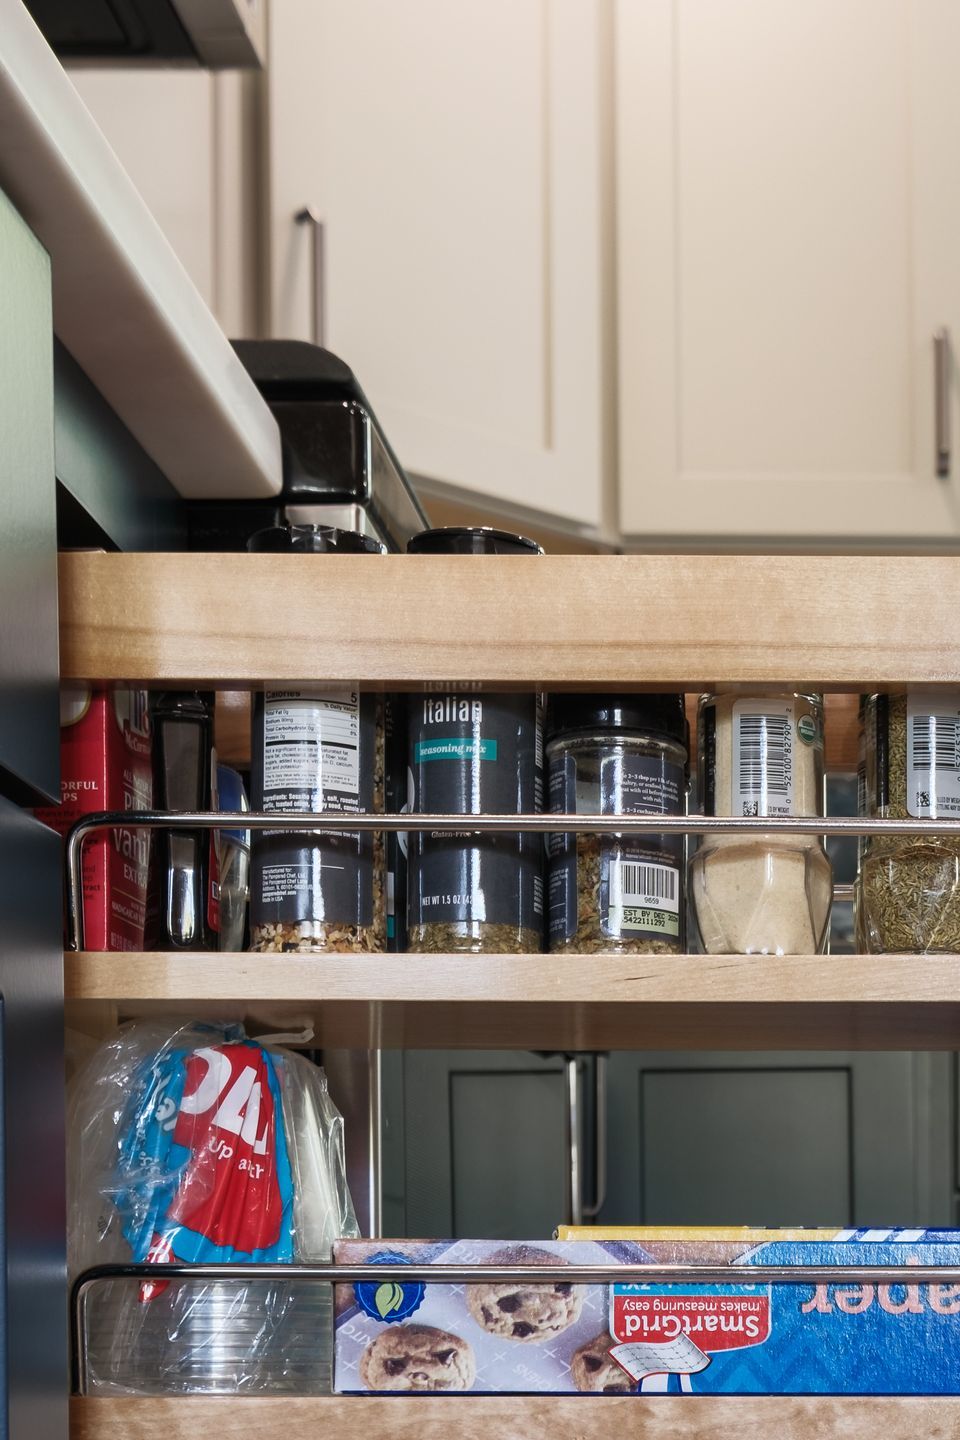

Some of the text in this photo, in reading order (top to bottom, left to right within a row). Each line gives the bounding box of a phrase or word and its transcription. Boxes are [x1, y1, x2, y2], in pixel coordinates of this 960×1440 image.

[423, 697, 482, 724] Italian
[432, 895, 440, 905] WT
[442, 895, 451, 905] 1.5
[622, 1298, 761, 1313] makes measuring easy
[622, 1314, 760, 1337] SmartGrid
